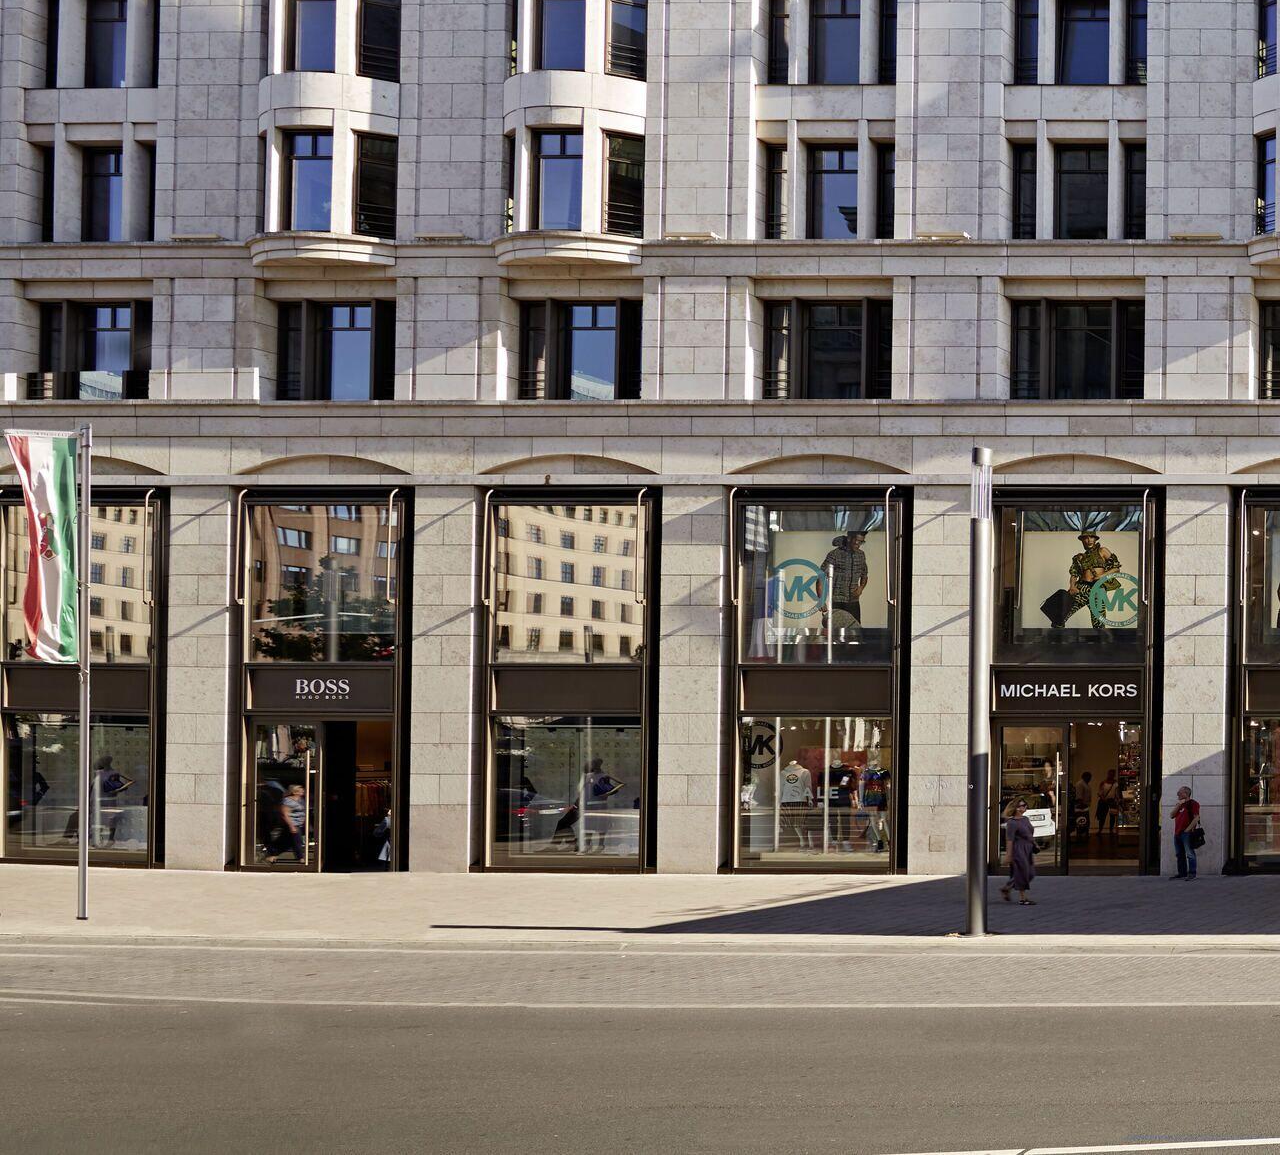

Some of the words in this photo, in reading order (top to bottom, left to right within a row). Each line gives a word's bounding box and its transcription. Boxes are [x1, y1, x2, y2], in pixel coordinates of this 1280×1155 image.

[296, 679, 350, 694] BOSS
[1000, 684, 1080, 697] MICHAEL
[1088, 684, 1138, 697] KORS
